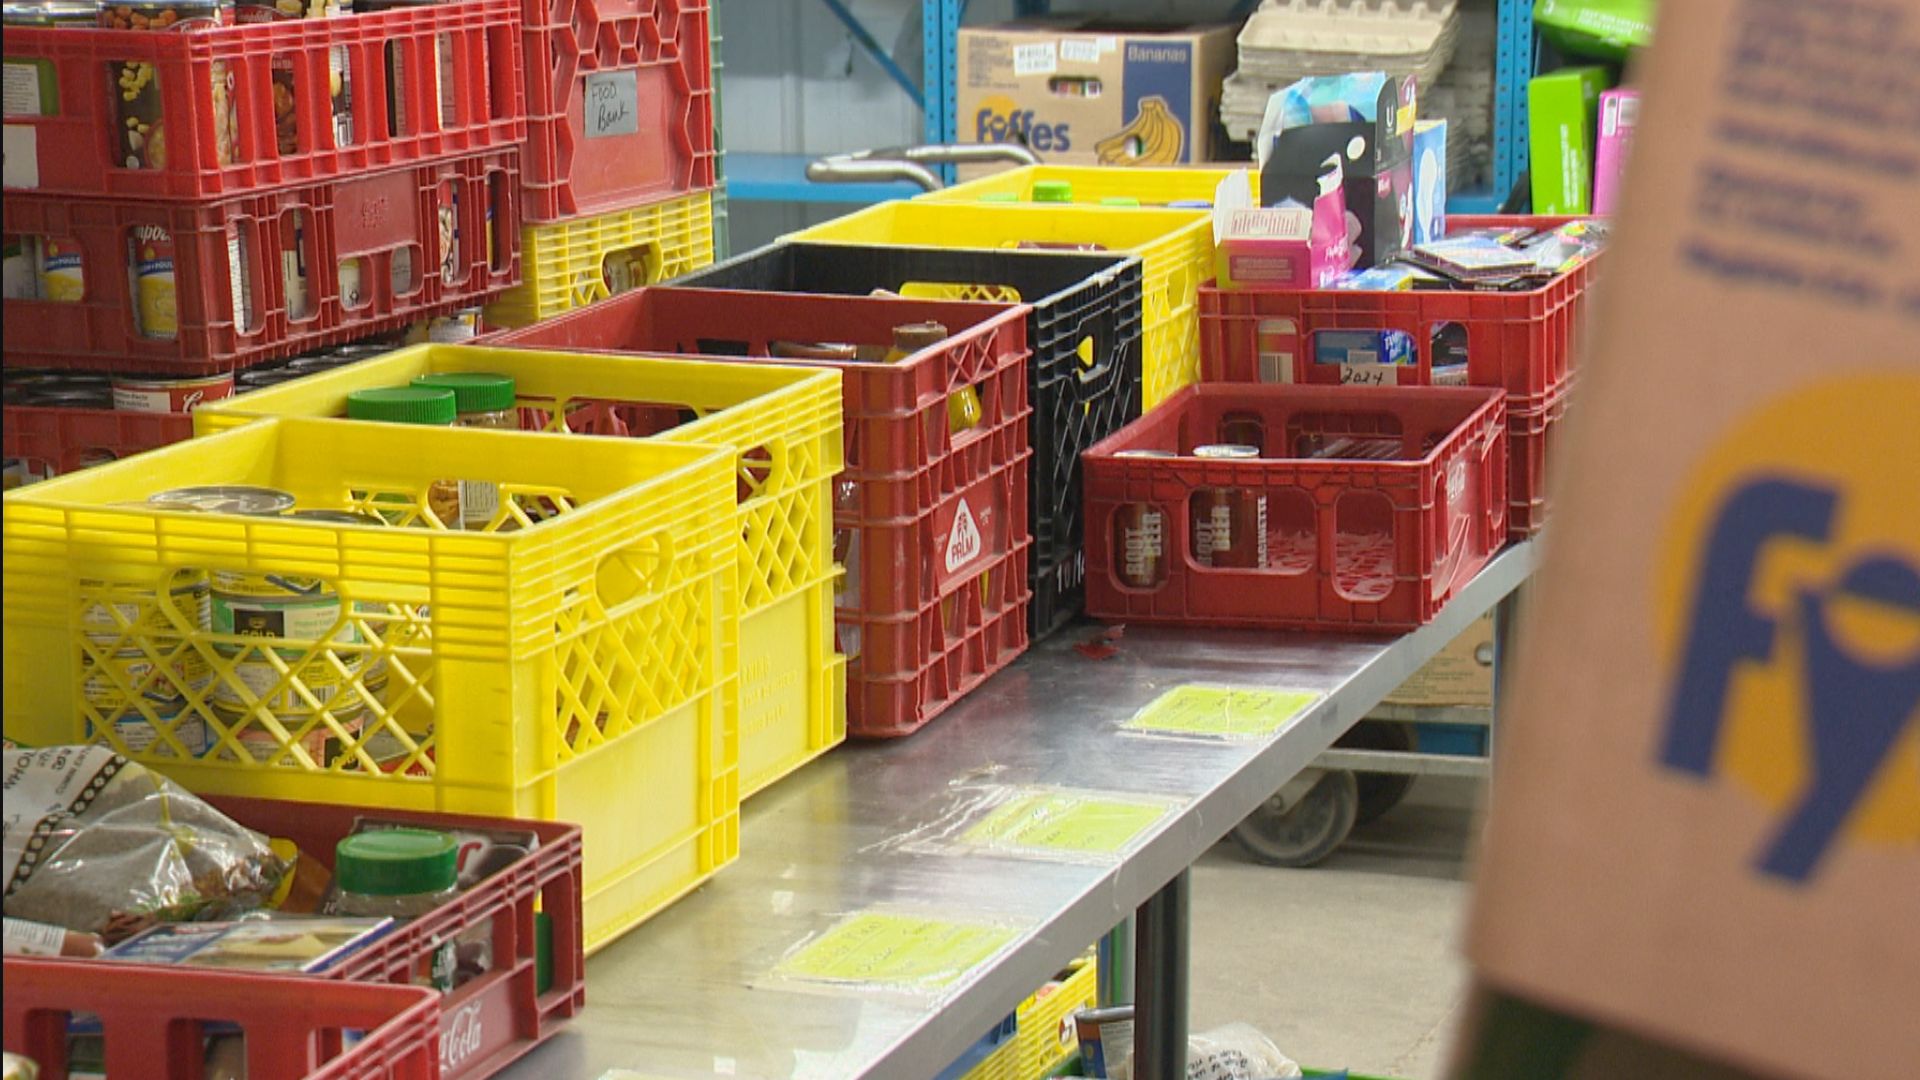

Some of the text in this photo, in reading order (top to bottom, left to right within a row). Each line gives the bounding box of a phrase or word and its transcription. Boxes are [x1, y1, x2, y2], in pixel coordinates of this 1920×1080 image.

[1128, 46, 1187, 62] Bananas
[598, 99, 630, 132] Bank
[1341, 365, 1383, 386] 2024
[1142, 512, 1162, 557] BEER
[1211, 506, 1231, 551] BEER
[951, 535, 974, 564] PALM
[1125, 528, 1144, 575] ROOT
